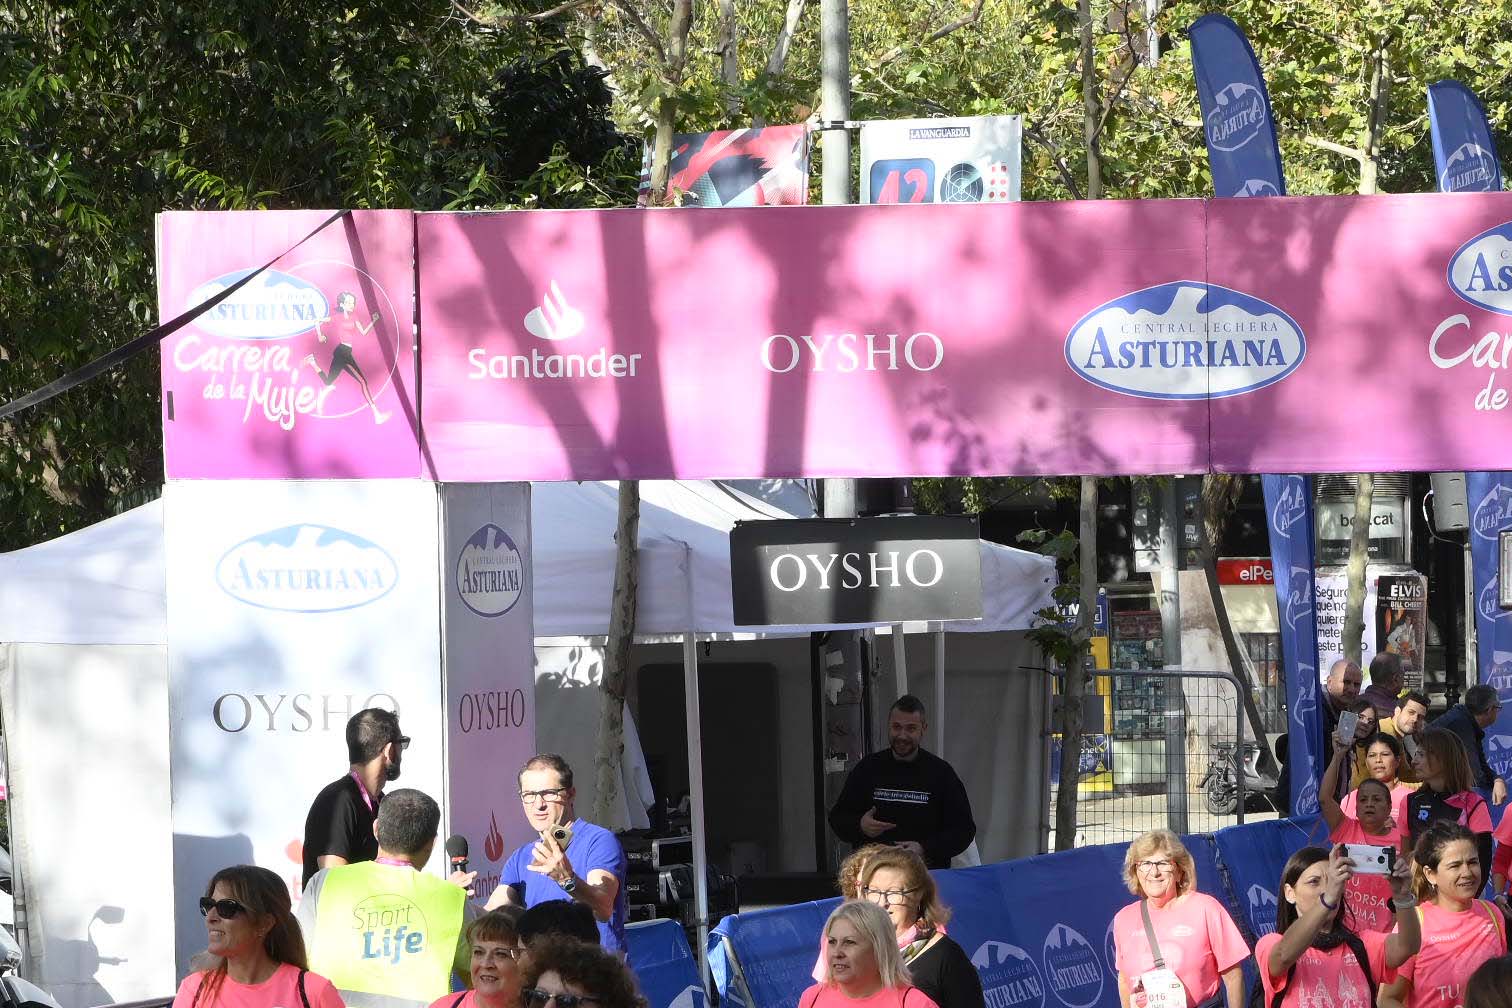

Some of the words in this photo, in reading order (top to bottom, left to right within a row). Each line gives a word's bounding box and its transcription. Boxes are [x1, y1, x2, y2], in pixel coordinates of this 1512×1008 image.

[1121, 323, 1195, 334] CENTRAL
[1204, 321, 1278, 333] LECHERA
[174, 335, 292, 371] Carrera
[468, 347, 641, 379] Santander
[761, 332, 944, 374] OYSHO
[1084, 326, 1287, 368] ASTURIANA
[203, 374, 223, 399] de
[230, 373, 245, 399] la
[243, 368, 336, 431] Mujer
[1474, 372, 1509, 410] de
[231, 557, 385, 590] ASTURIANA
[462, 559, 519, 594] ASTURIANA
[770, 549, 944, 592] OYSHO
[1390, 584, 1422, 598] ELVIS
[459, 689, 525, 734] OYSHO
[352, 904, 414, 932] Sport
[362, 925, 424, 964] Life
[1048, 960, 1100, 992] ASTURIANA
[1437, 984, 1460, 1000] TU
